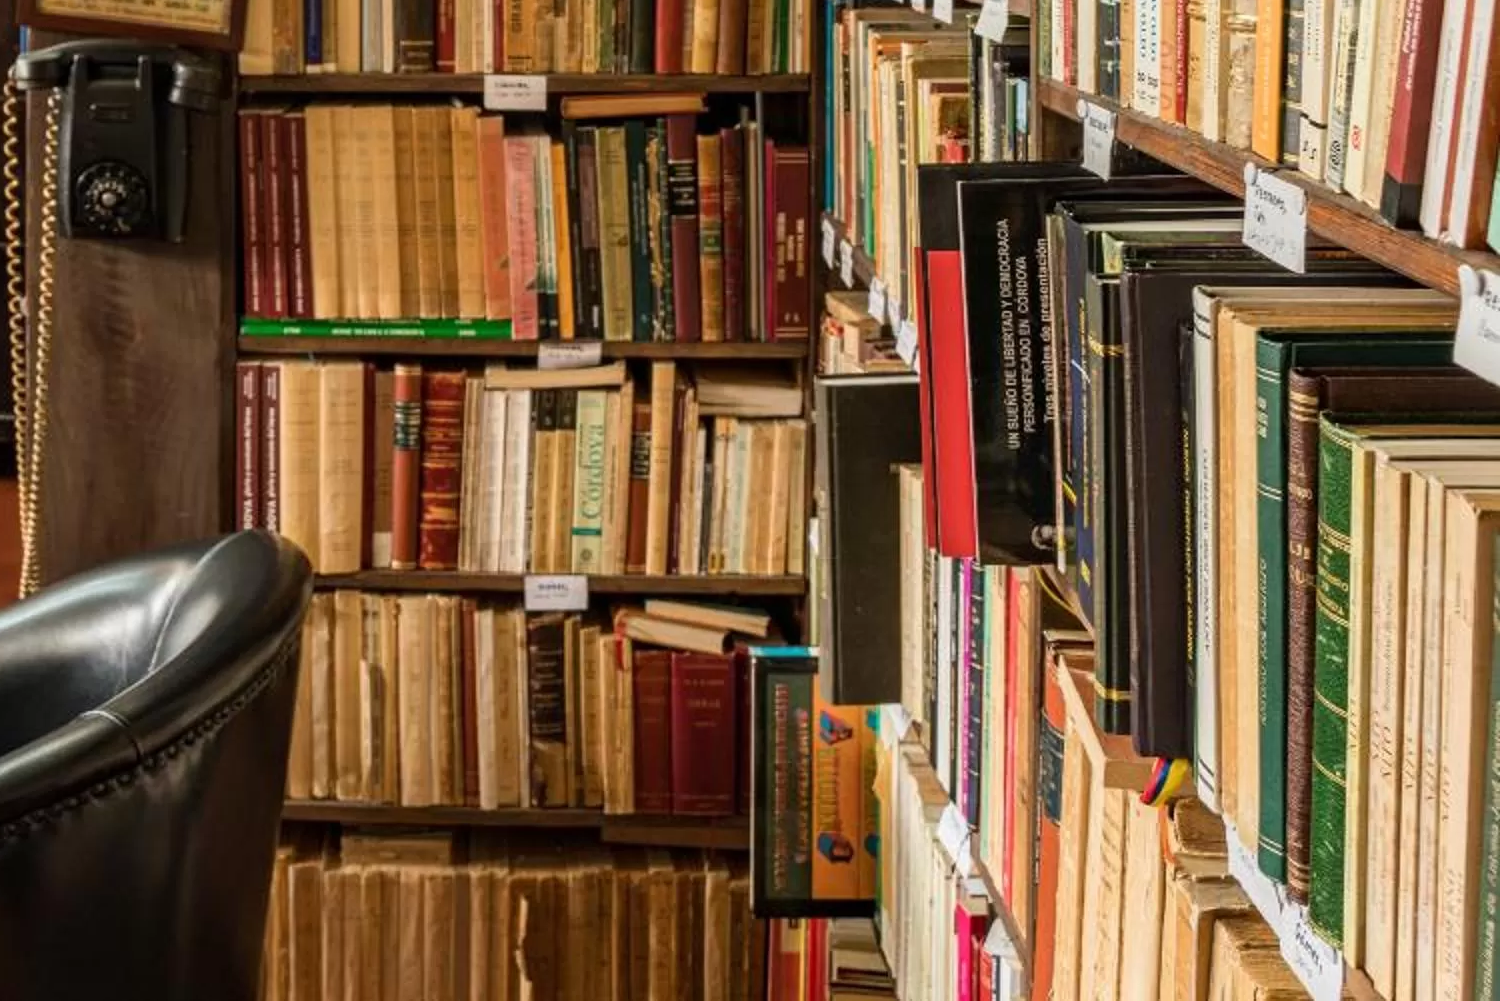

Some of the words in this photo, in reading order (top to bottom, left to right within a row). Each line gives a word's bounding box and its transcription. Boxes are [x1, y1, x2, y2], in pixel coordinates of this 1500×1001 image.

[996, 218, 1013, 298] DEMOCRACIA
[1036, 237, 1053, 323] presentación
[999, 299, 1011, 307] Y
[1014, 255, 1030, 314] CÓRDOVA
[1000, 310, 1017, 369] LIBERTAD
[1018, 318, 1031, 335] EN
[1039, 325, 1053, 342] de
[1004, 371, 1018, 386] DE
[1019, 337, 1037, 433] PERSONIFICADO
[1040, 343, 1055, 393] niveles
[1004, 388, 1019, 430] SUEÑO
[1043, 394, 1057, 424] Tres
[1007, 433, 1021, 449] UN
[578, 424, 604, 520] Córdova
